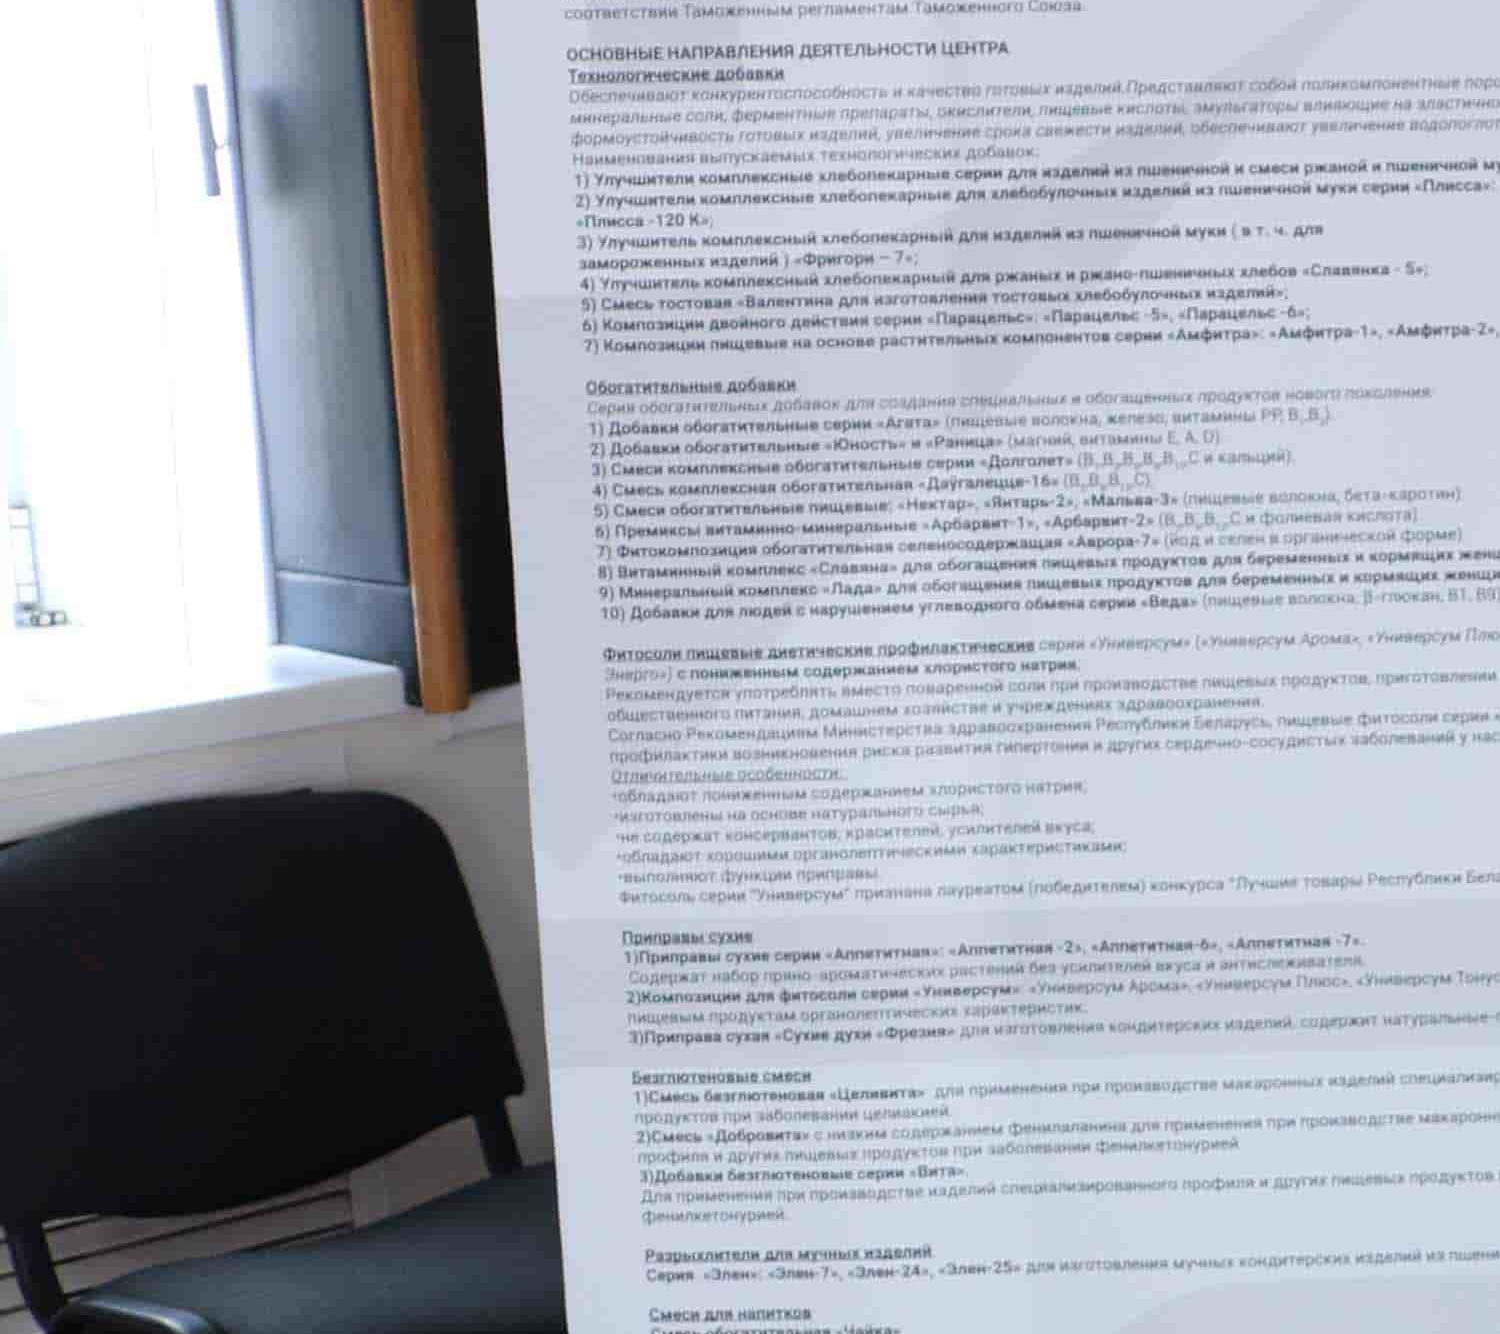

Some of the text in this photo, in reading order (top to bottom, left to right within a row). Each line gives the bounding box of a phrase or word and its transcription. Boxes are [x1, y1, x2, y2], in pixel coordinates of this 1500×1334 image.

[566, 39, 1009, 62] ОСНОВНЫЕ НАПРАВЛЕНИЯ ДЕЯТЕЛЬНОСТИ ЦЕНТРА
[815, 335, 876, 350] основе
